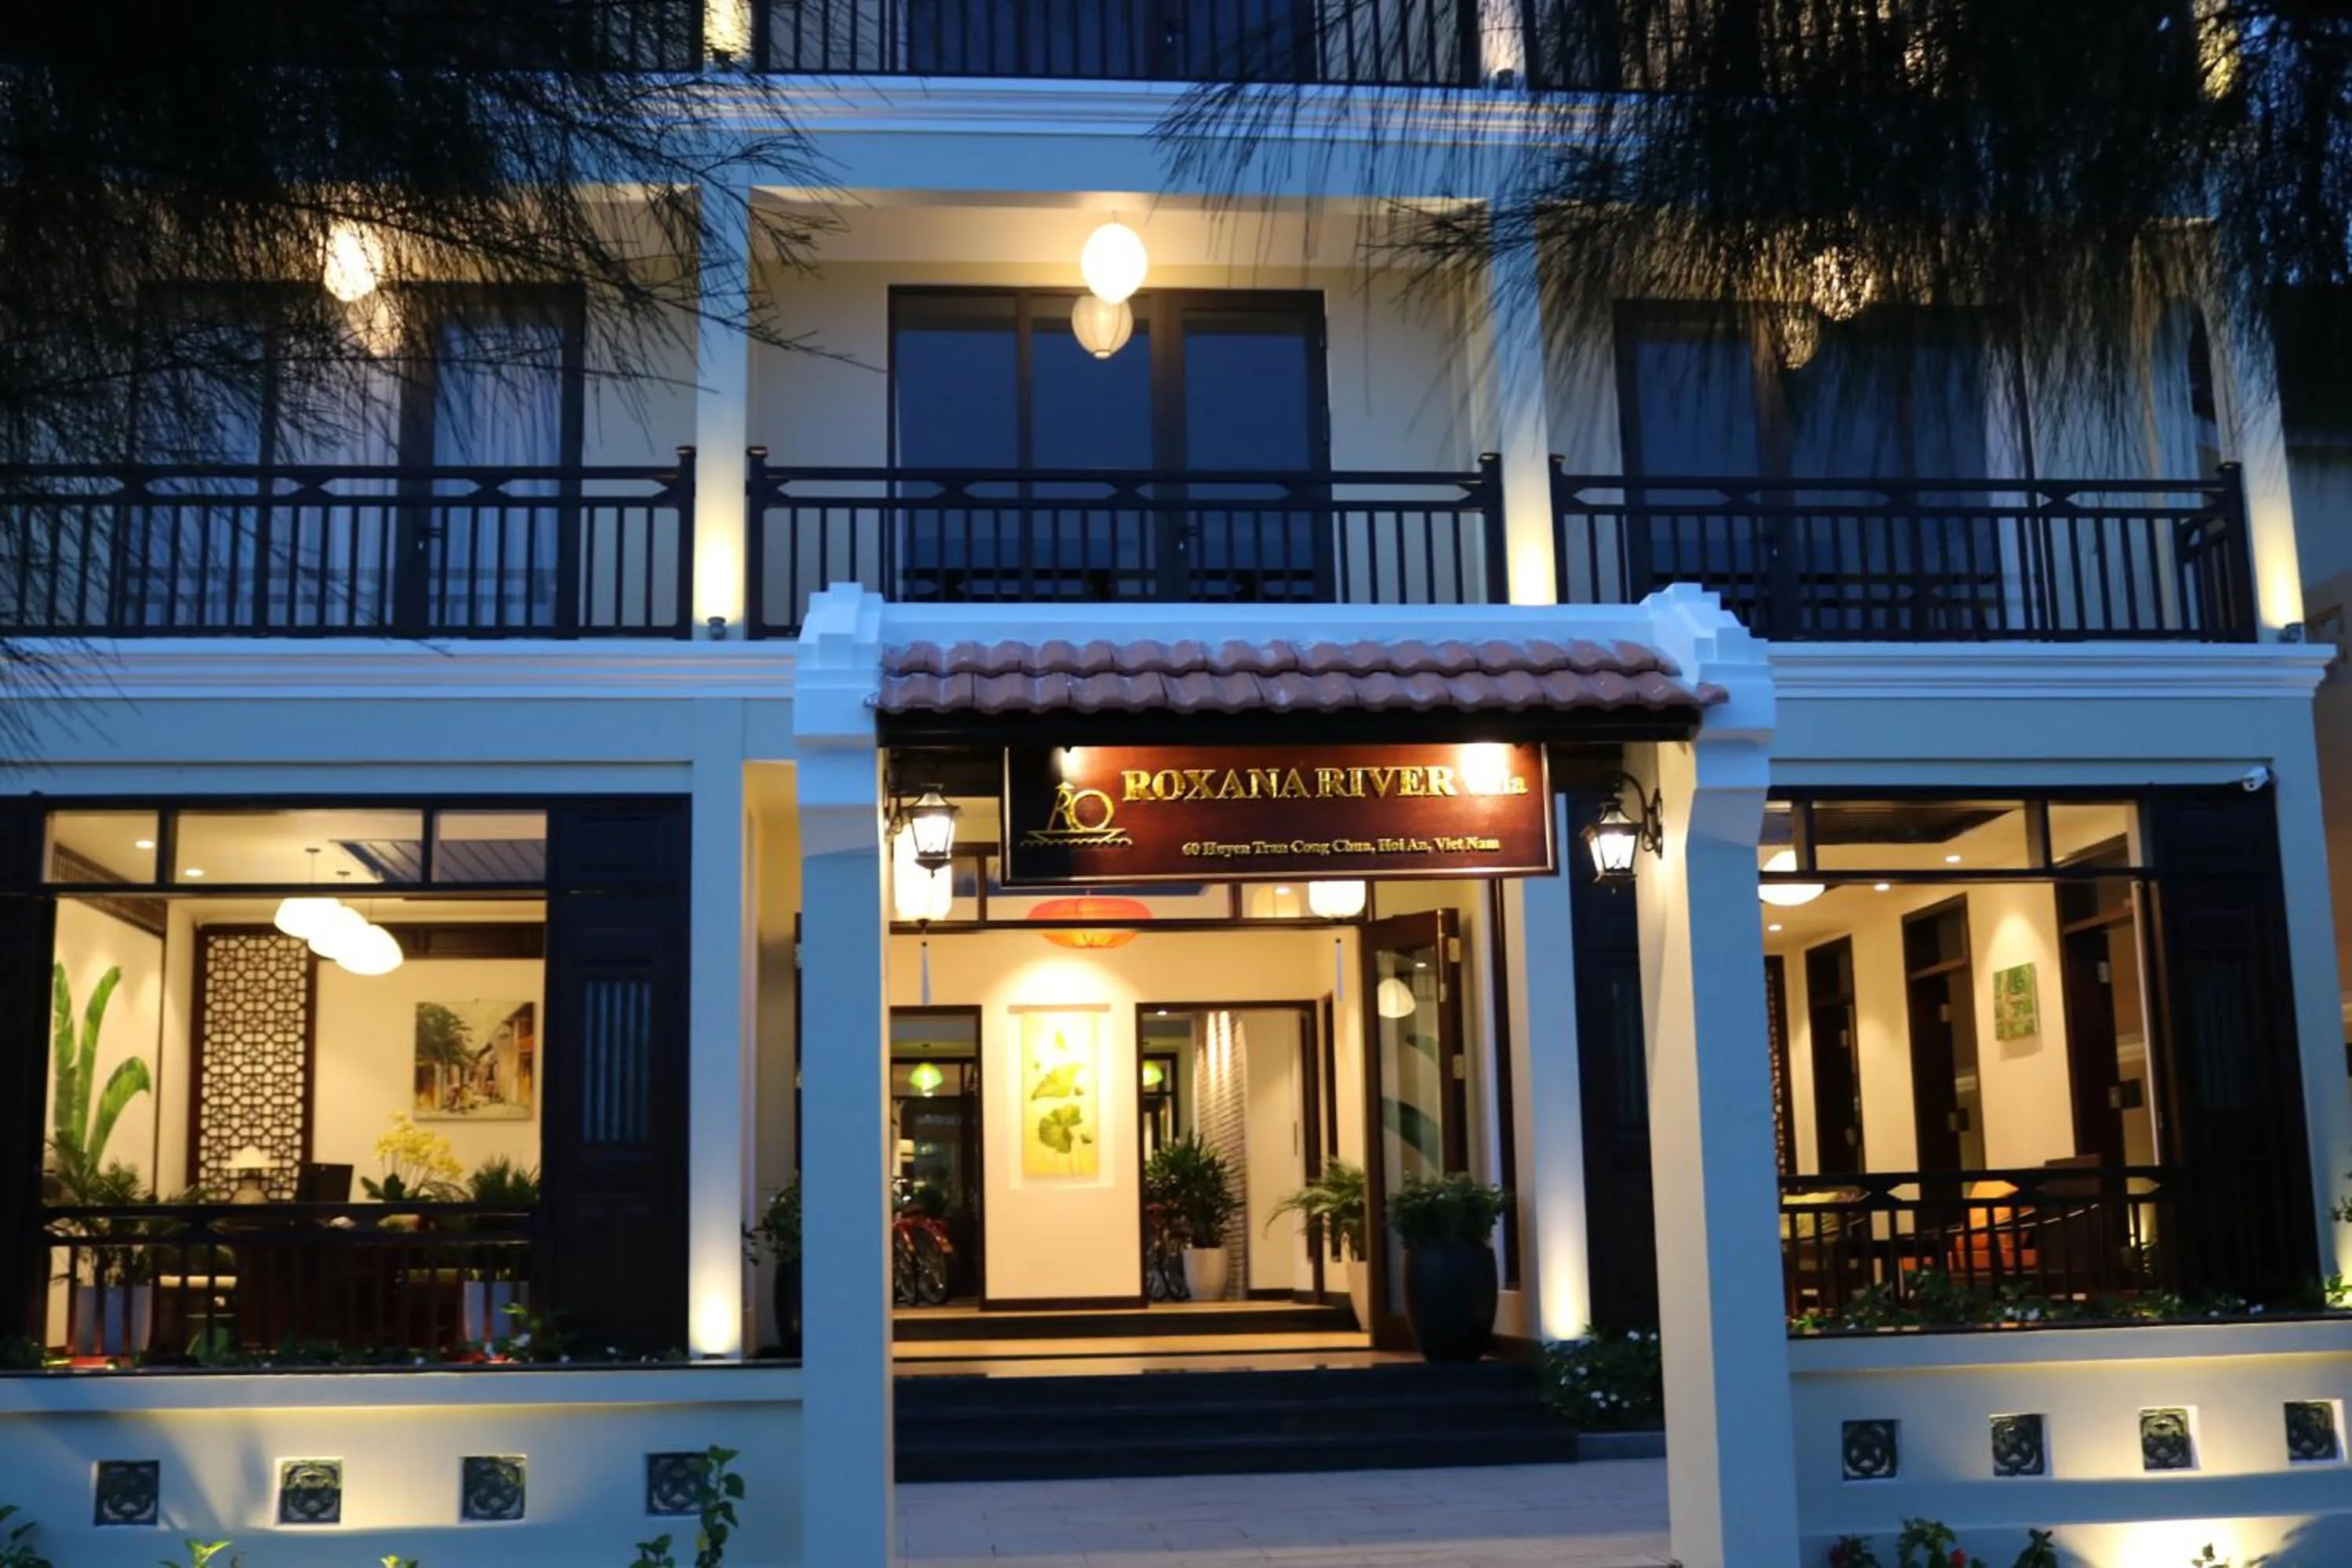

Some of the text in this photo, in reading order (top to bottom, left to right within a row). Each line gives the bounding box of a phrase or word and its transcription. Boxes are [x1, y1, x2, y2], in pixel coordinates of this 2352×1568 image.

[1120, 768, 1311, 801] ROXANA
[1315, 766, 1457, 797] RIVER
[1377, 838, 1405, 852] Hoi
